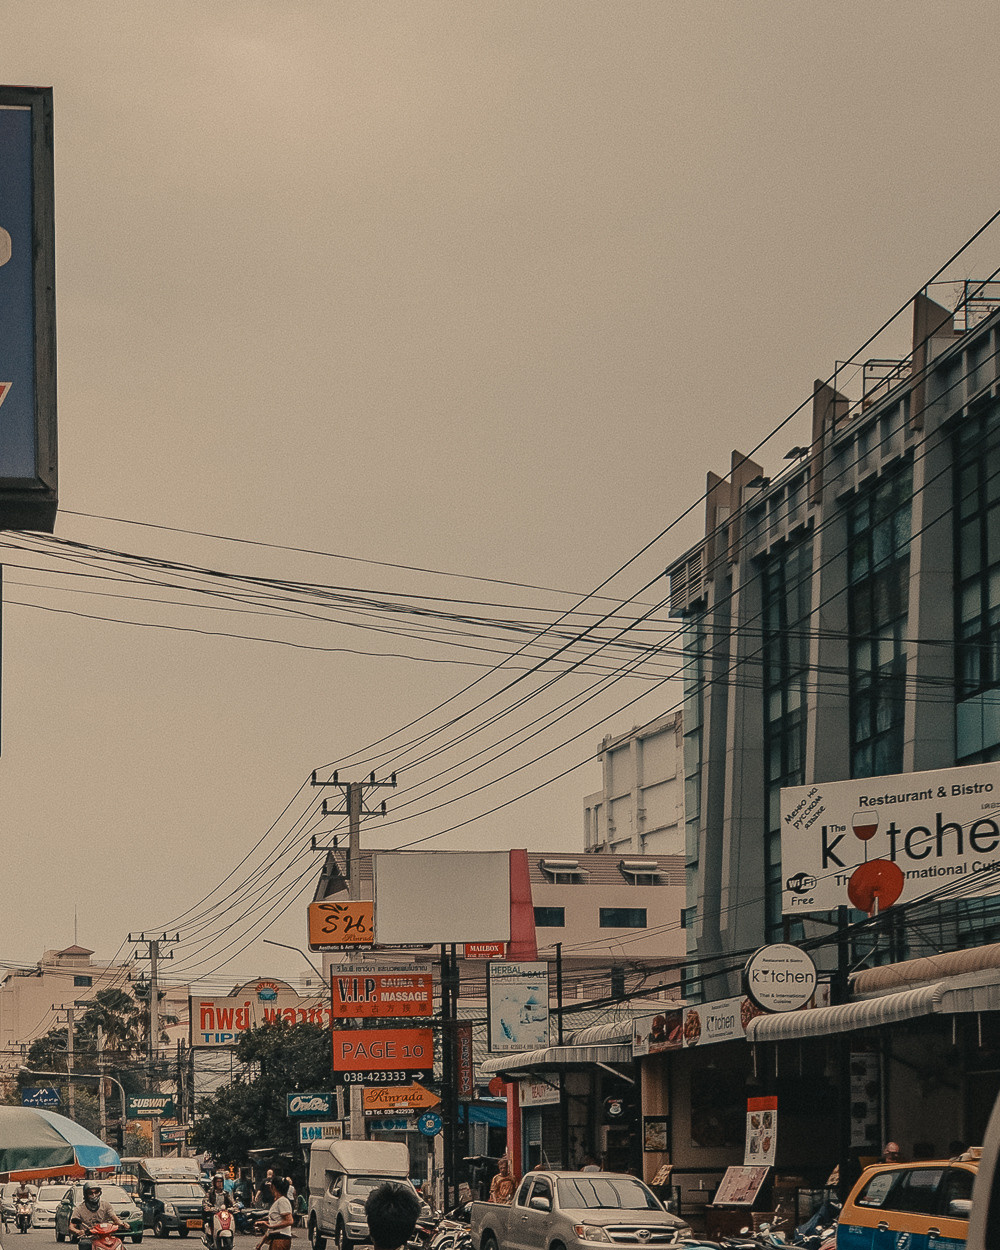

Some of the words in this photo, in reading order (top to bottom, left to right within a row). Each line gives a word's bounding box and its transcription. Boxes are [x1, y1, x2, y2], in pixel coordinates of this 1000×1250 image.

[859, 788, 933, 808] Restaurant
[937, 786, 947, 798] &
[951, 782, 993, 797] Bistro
[829, 824, 847, 833] The
[791, 896, 815, 906] Free
[338, 978, 378, 1003] V.I.P.
[381, 978, 413, 988] SAUNA
[417, 977, 425, 988] &
[381, 992, 428, 1002] MASSAGE
[200, 1001, 251, 1030] ทิพย์
[341, 1042, 397, 1059] PAGE
[401, 1045, 424, 1058] 10
[343, 1071, 406, 1082] 038-423333
[130, 1098, 168, 1108] SUBWAY
[302, 1127, 322, 1140] KOM
